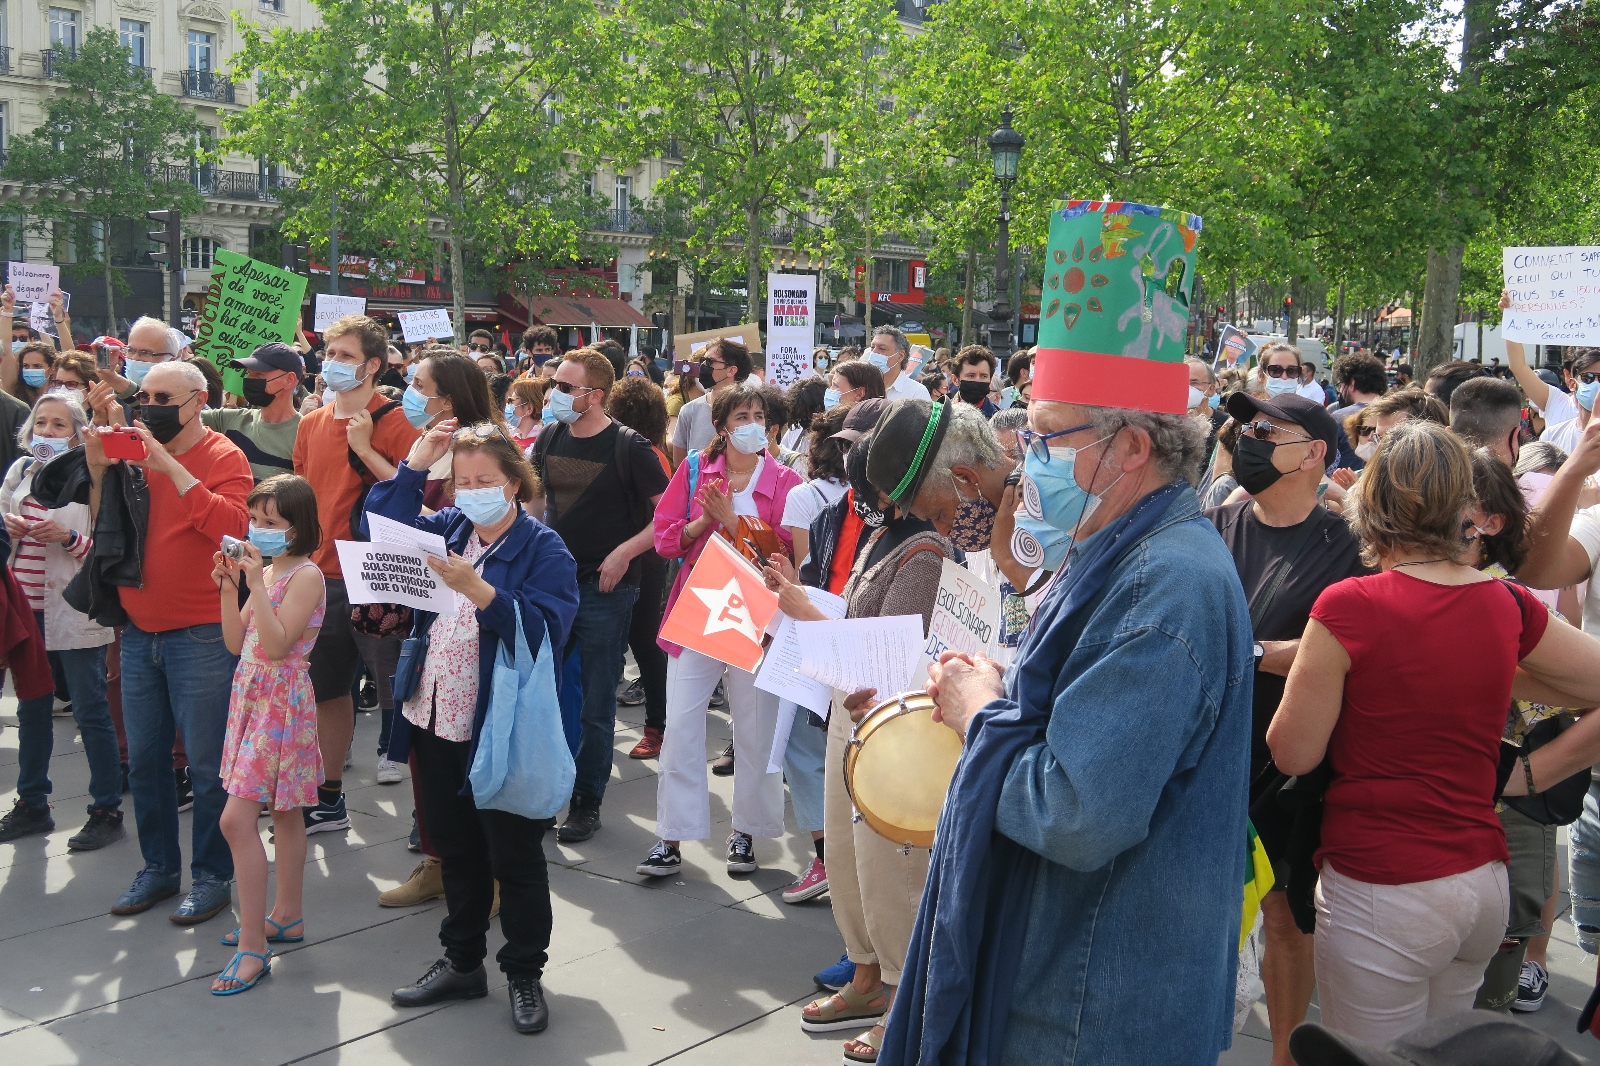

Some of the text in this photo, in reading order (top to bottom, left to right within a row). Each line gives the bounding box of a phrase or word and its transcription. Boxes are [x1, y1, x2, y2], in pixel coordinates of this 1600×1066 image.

[1513, 252, 1574, 269] COMMENT
[13, 266, 53, 280] Bolsonaro,
[233, 260, 291, 292] Apesar
[1507, 272, 1540, 284] CELUI
[1550, 270, 1572, 280] QUI
[228, 278, 285, 310] de você,
[773, 289, 808, 299] BOLSONARO
[878, 293, 892, 302] KFC
[1509, 289, 1540, 301] PLUS
[1549, 290, 1565, 300] DE
[224, 296, 280, 324] amanhã
[773, 305, 809, 316] MATA
[220, 309, 242, 328] há
[240, 320, 256, 335] de
[773, 316, 784, 327] NO
[218, 331, 252, 350] outro
[780, 346, 798, 355] FORA
[365, 552, 422, 567] O GOVERNO
[362, 561, 431, 579] BOLSONARO É
[361, 571, 437, 590] MAIS PERIGOSO
[370, 581, 433, 599] QUE O VÍRUS.
[954, 577, 986, 615] STOP
[936, 586, 992, 645] BOLSONARO
